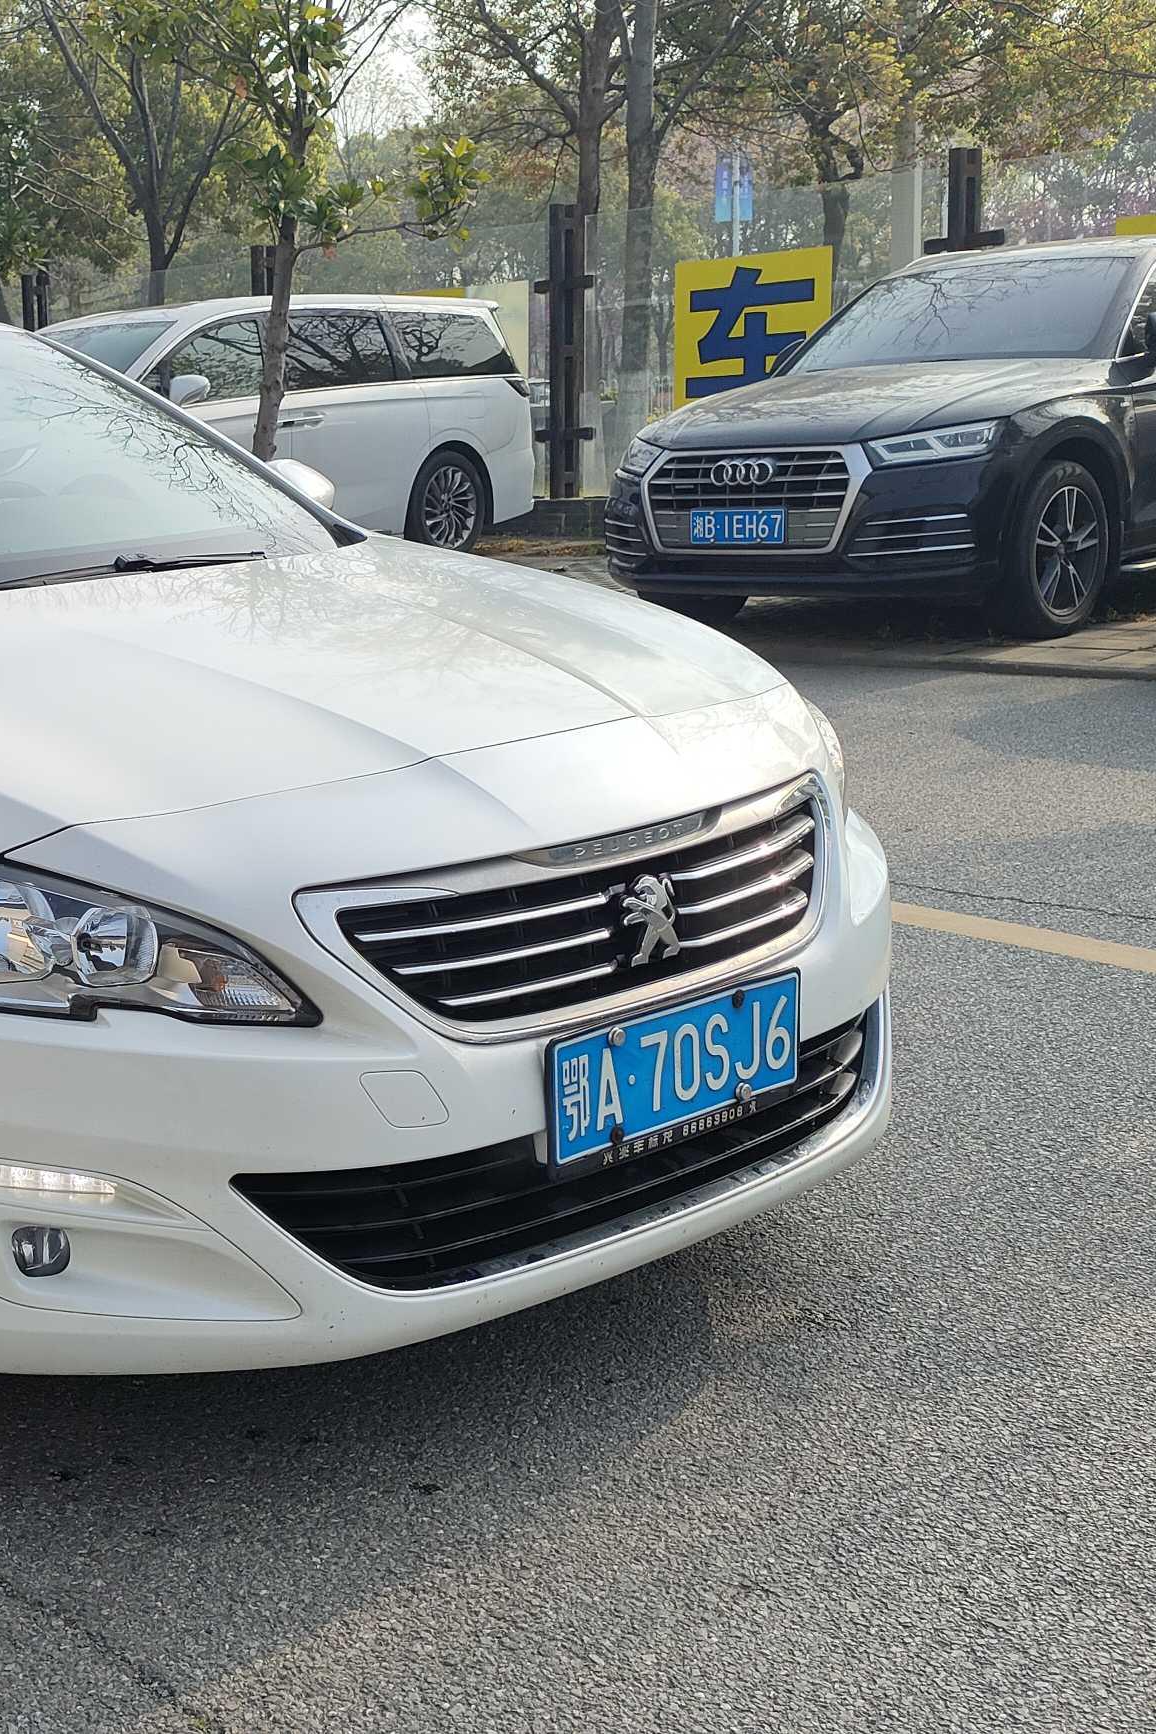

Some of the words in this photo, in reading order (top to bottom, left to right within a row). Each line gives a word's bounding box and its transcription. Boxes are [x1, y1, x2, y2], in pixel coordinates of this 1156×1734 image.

[685, 266, 816, 399] 车
[574, 822, 684, 858] PEUGEOT
[561, 994, 792, 1142] 鄂A·70SJ6
